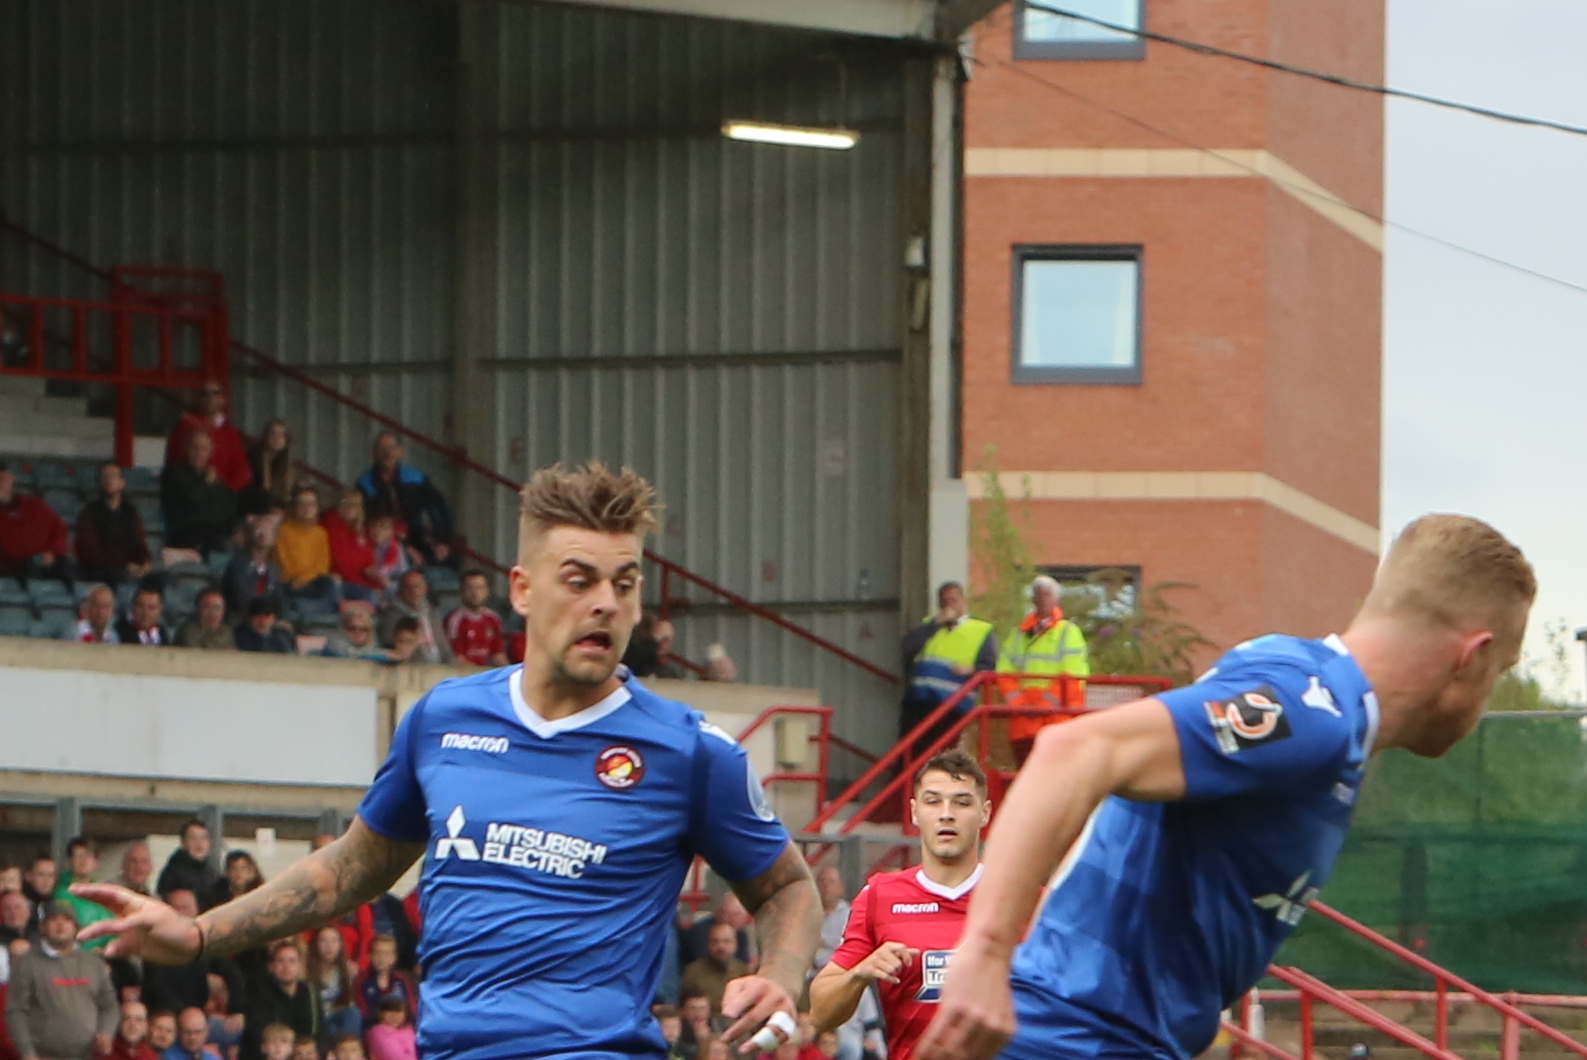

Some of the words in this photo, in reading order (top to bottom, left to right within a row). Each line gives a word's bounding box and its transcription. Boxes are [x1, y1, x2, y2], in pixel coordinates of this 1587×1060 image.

[441, 732, 509, 754] macron
[486, 821, 607, 865] MITSUBISHI
[482, 841, 585, 879] ELECTRIC
[892, 902, 939, 914] macron
